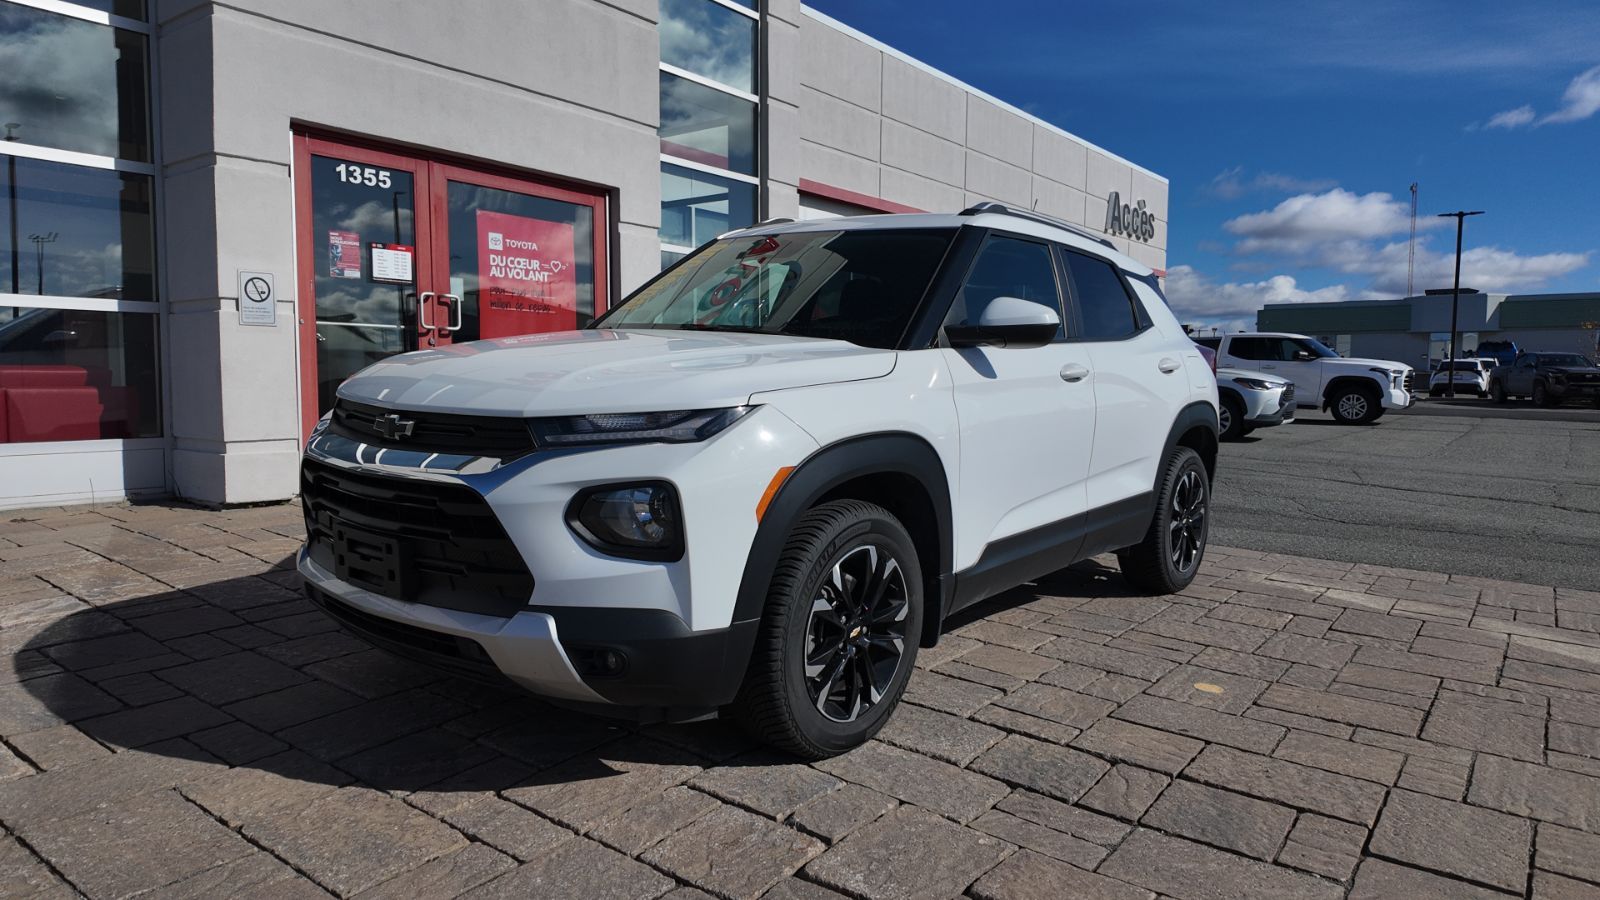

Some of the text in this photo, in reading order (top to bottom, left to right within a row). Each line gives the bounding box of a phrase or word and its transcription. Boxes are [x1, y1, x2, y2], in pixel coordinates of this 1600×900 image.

[335, 163, 392, 189] 1355
[1104, 191, 1155, 240] Accès
[505, 239, 538, 251] TOYOTA
[489, 254, 540, 270] DU CŒUR
[489, 266, 549, 283] AU VOLANT
